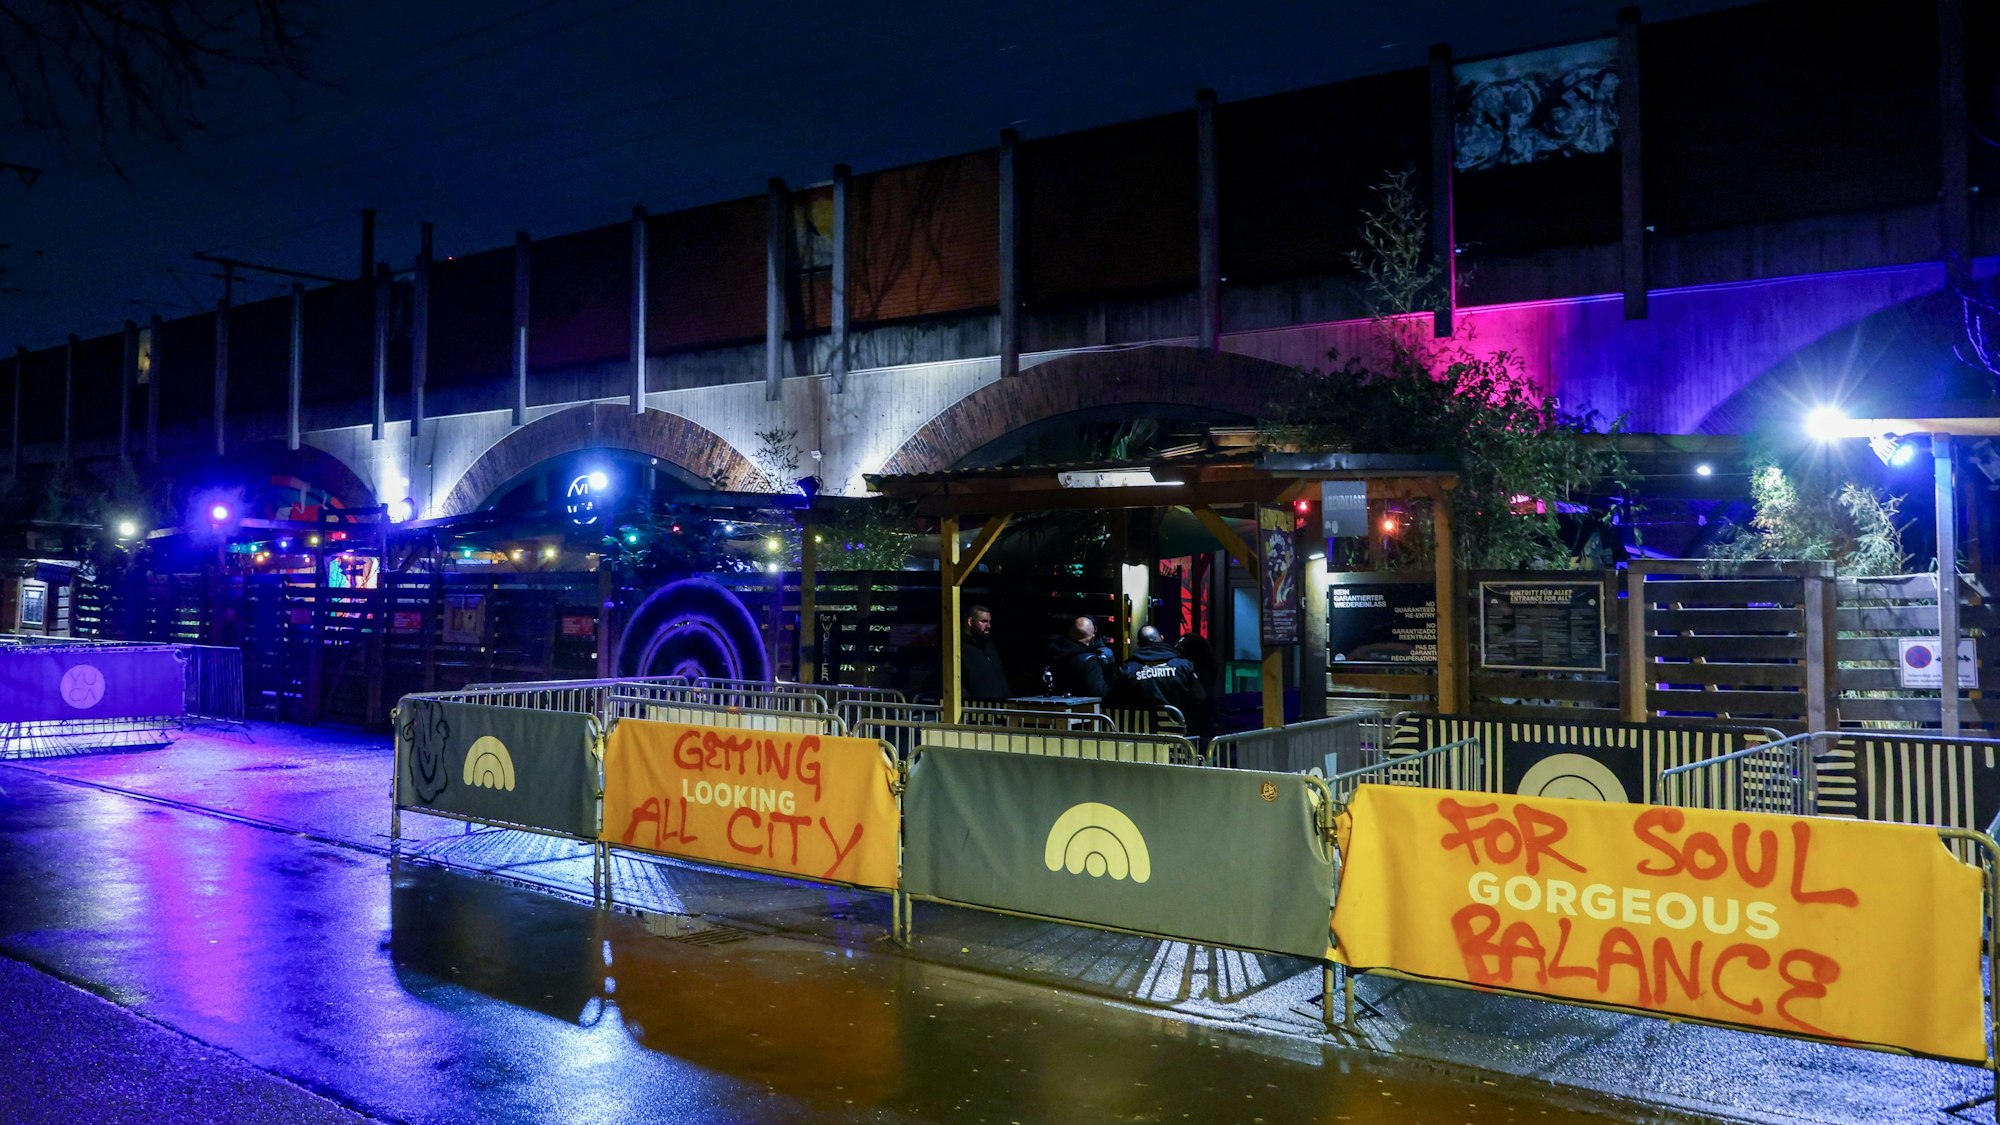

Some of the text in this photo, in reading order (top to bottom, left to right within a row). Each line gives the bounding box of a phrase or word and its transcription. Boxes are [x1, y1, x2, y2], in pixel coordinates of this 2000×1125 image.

[1135, 667, 1177, 681] SECURITY
[622, 797, 699, 849] ALL
[682, 778, 796, 815] LOOKING
[1437, 798, 1859, 908] FOR SOUL
[1467, 870, 1781, 940] GORGEOUS
[1450, 903, 1842, 1037] BALANCE
